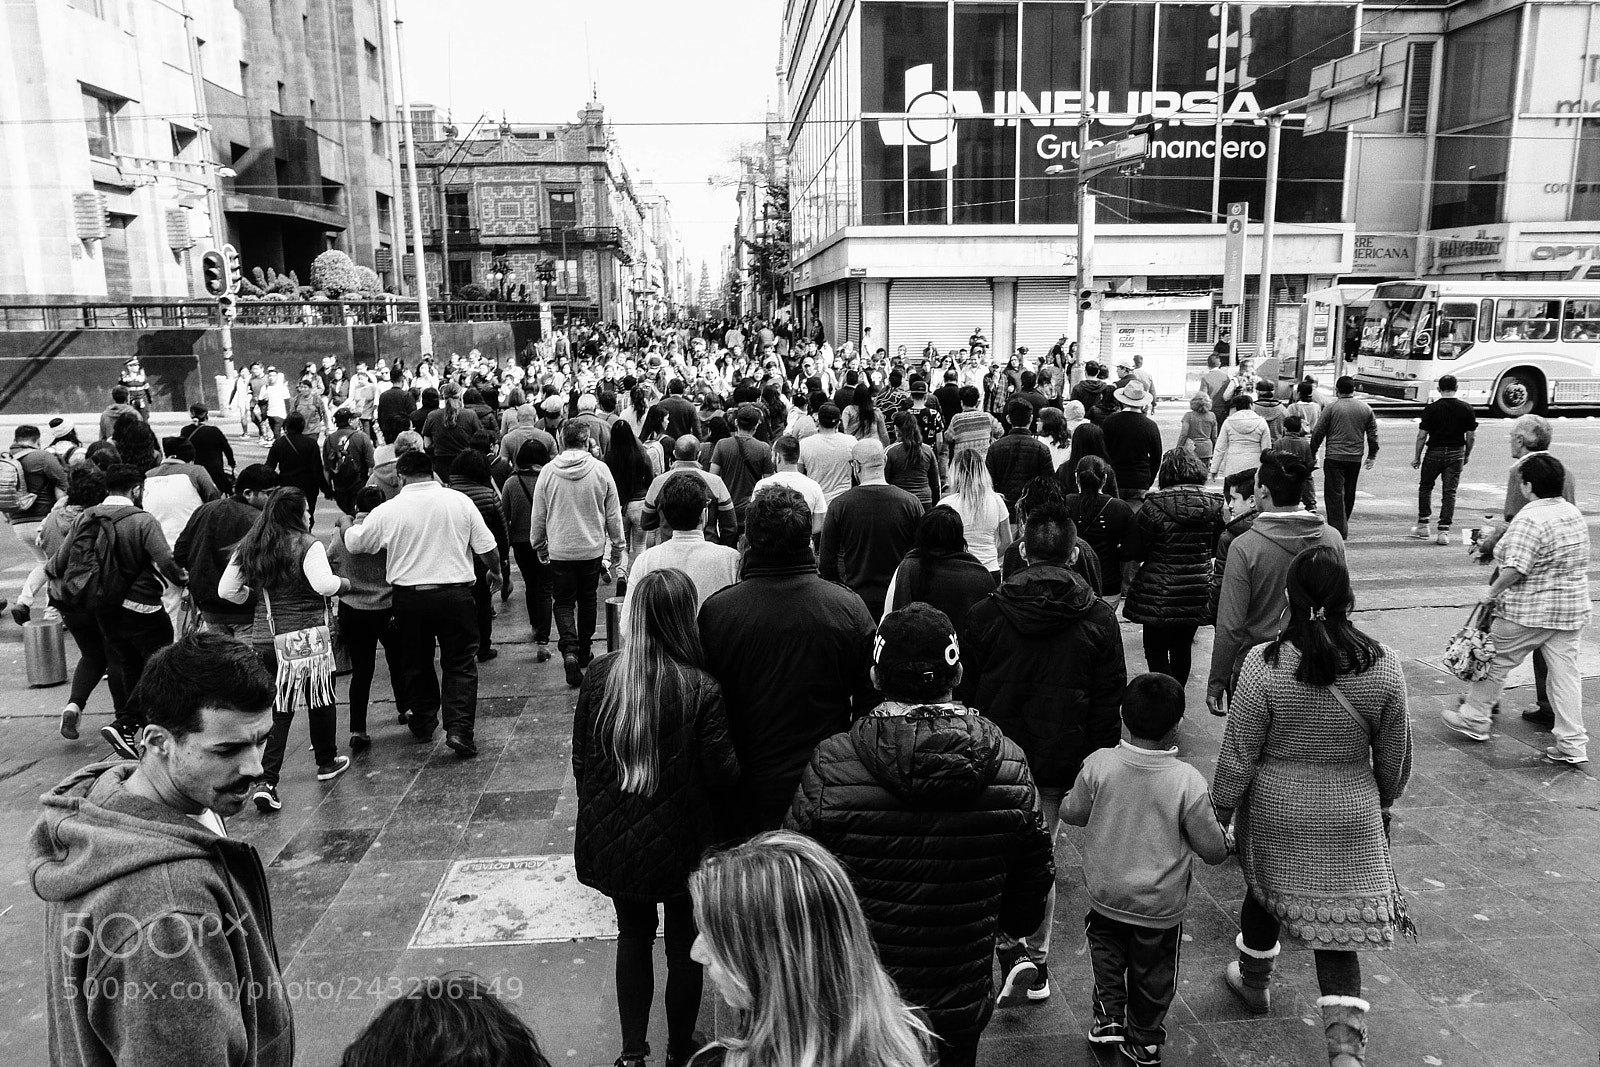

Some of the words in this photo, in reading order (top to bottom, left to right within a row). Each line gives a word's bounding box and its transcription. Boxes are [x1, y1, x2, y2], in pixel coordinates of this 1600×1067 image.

[994, 90, 1267, 127] INBURSA
[1037, 134, 1117, 159] Gru
[1128, 134, 1266, 159] nancero
